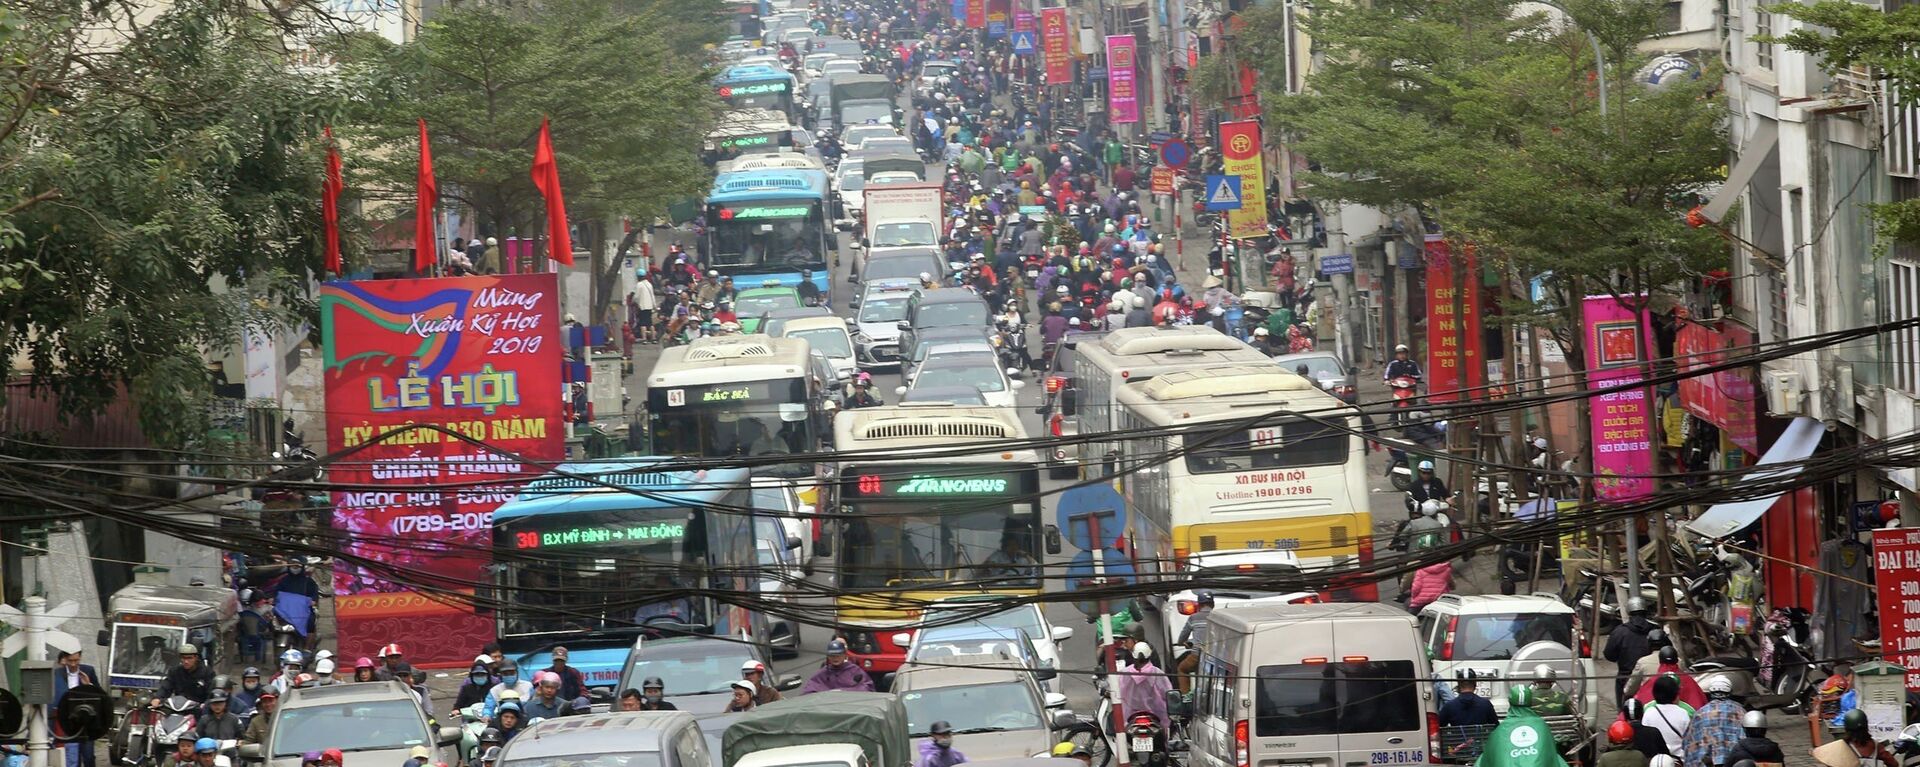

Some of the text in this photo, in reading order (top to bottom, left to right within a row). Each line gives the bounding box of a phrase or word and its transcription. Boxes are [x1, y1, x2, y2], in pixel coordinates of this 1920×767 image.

[473, 287, 543, 310] Mừng
[405, 312, 542, 337] Xuân Kỷ Hợi
[487, 335, 543, 354] 2019
[368, 360, 519, 414] LỄ HỘI
[670, 391, 682, 404] 41
[343, 415, 546, 448] KỶ NIỆM 230 NĂM
[1256, 429, 1275, 445] 01
[372, 447, 521, 480] CHIẾN THẮNG
[858, 475, 881, 494] 01
[1251, 473, 1268, 484] BUS
[1271, 470, 1284, 482] HÀ
[1286, 469, 1306, 483] NỘI
[346, 490, 403, 512] NGỌC
[1223, 486, 1313, 500] Hotline 1900.1296
[516, 531, 538, 549] 30
[580, 527, 610, 544] ĐÌNH
[627, 526, 648, 540] MAI
[1878, 551, 1902, 573] ĐẠI
[1371, 750, 1424, 765] 29B-161.46
[1510, 746, 1539, 759] Grab
